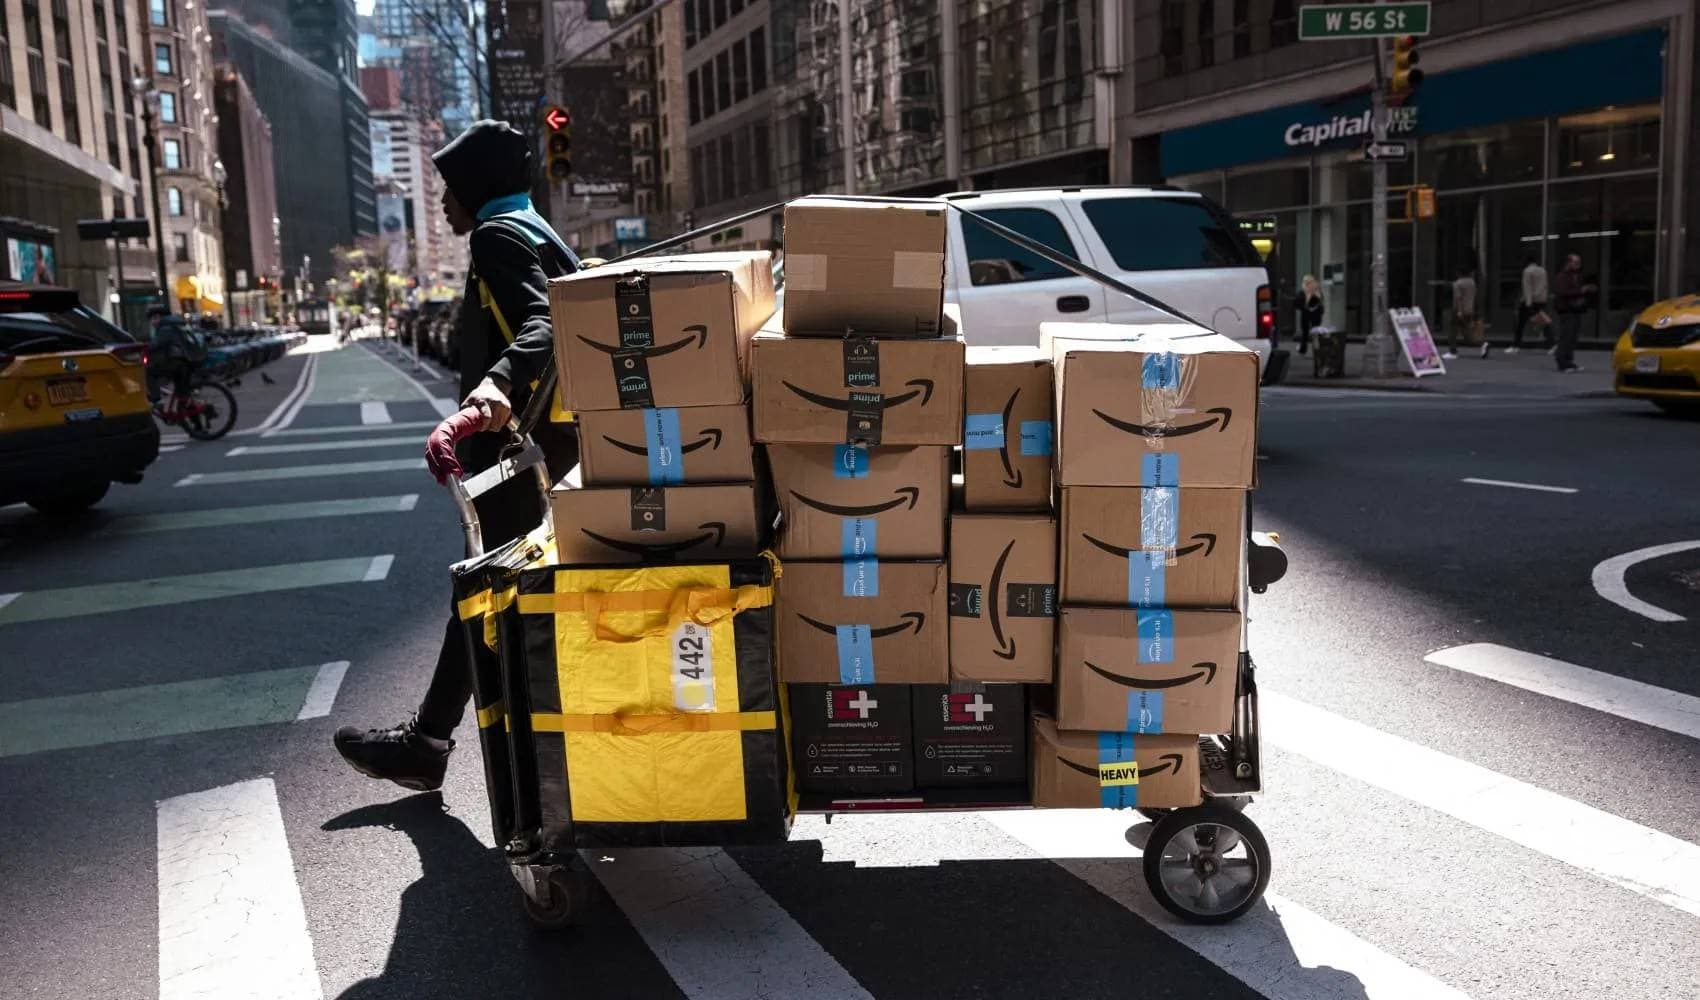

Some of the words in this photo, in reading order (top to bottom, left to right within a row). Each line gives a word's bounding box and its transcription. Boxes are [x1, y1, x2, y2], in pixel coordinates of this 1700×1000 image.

[1325, 11, 1342, 31] W
[1349, 11, 1377, 30] 56
[1383, 9, 1407, 29] St
[1284, 109, 1371, 146] Capital
[623, 330, 651, 342] prime
[621, 380, 647, 392] prime
[848, 371, 877, 383] prime
[853, 394, 880, 404] prime
[1043, 588, 1053, 614] prime
[679, 637, 705, 680] 442
[826, 690, 834, 719] essentia
[1101, 767, 1137, 781] HEAVY
